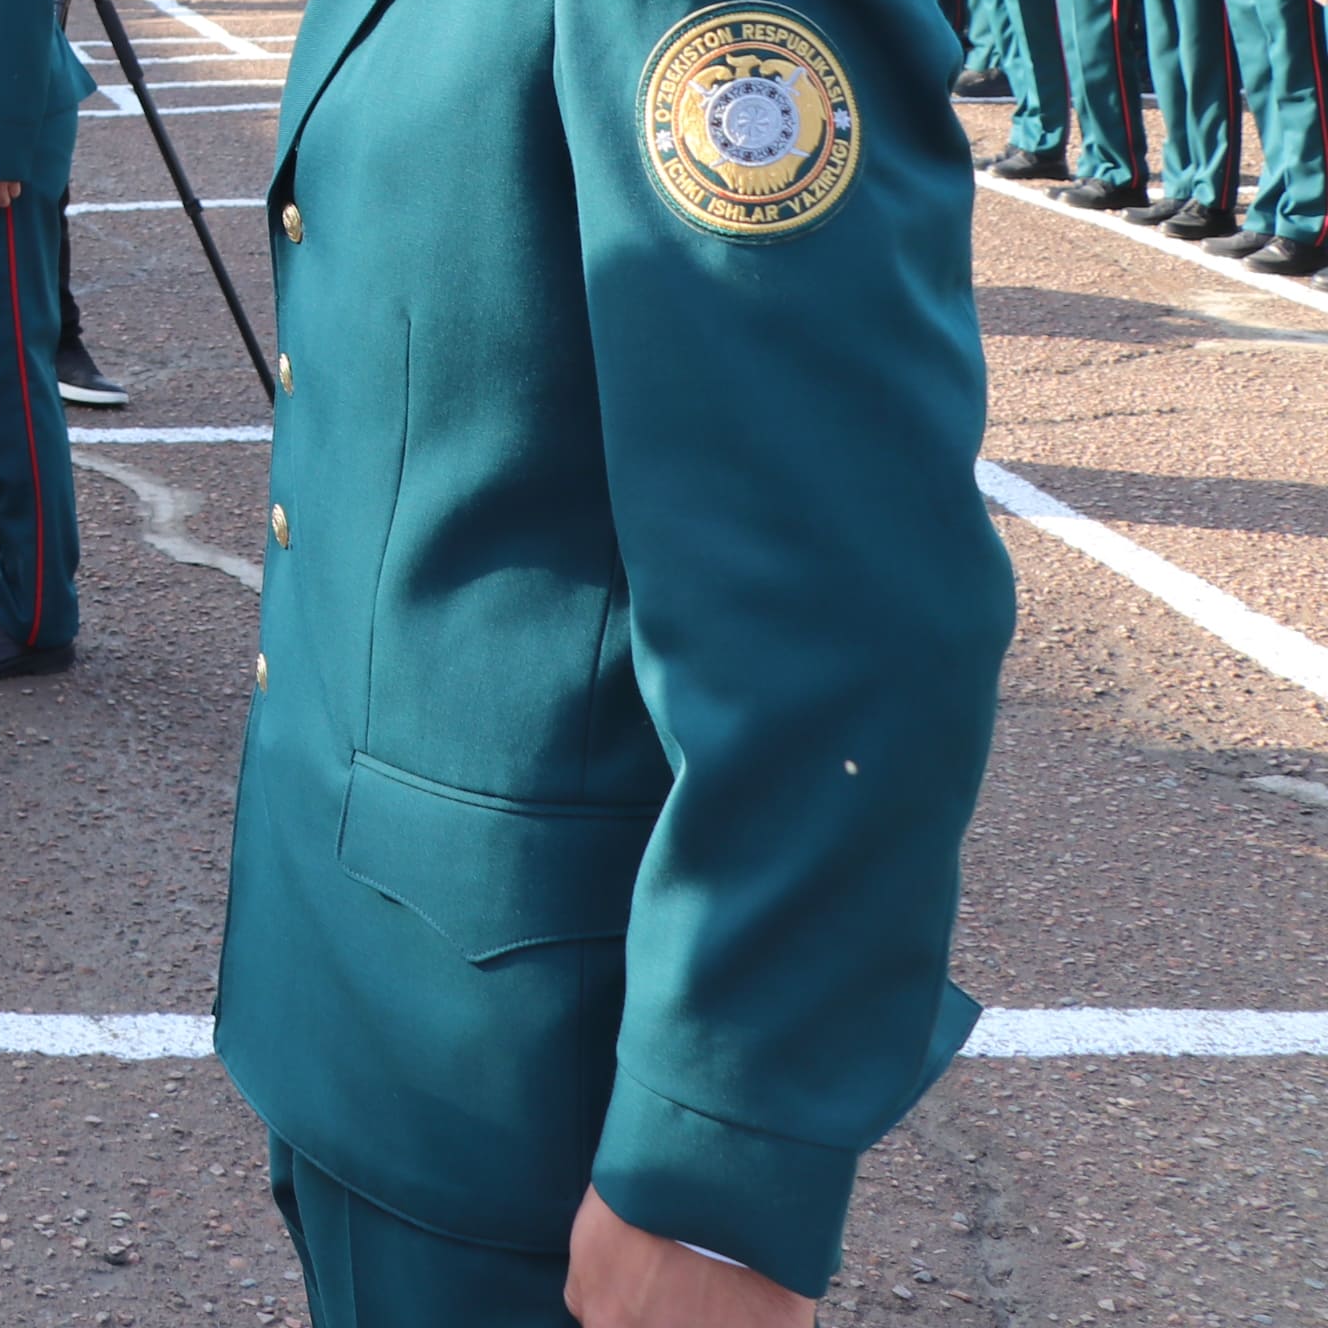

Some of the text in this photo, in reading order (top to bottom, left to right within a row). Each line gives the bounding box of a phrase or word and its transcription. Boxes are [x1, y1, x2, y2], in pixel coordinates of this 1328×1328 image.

[742, 23, 845, 104] RESPUBLIKASI
[664, 139, 849, 223] ICHKI ISHLAR VAZIRLIGI
